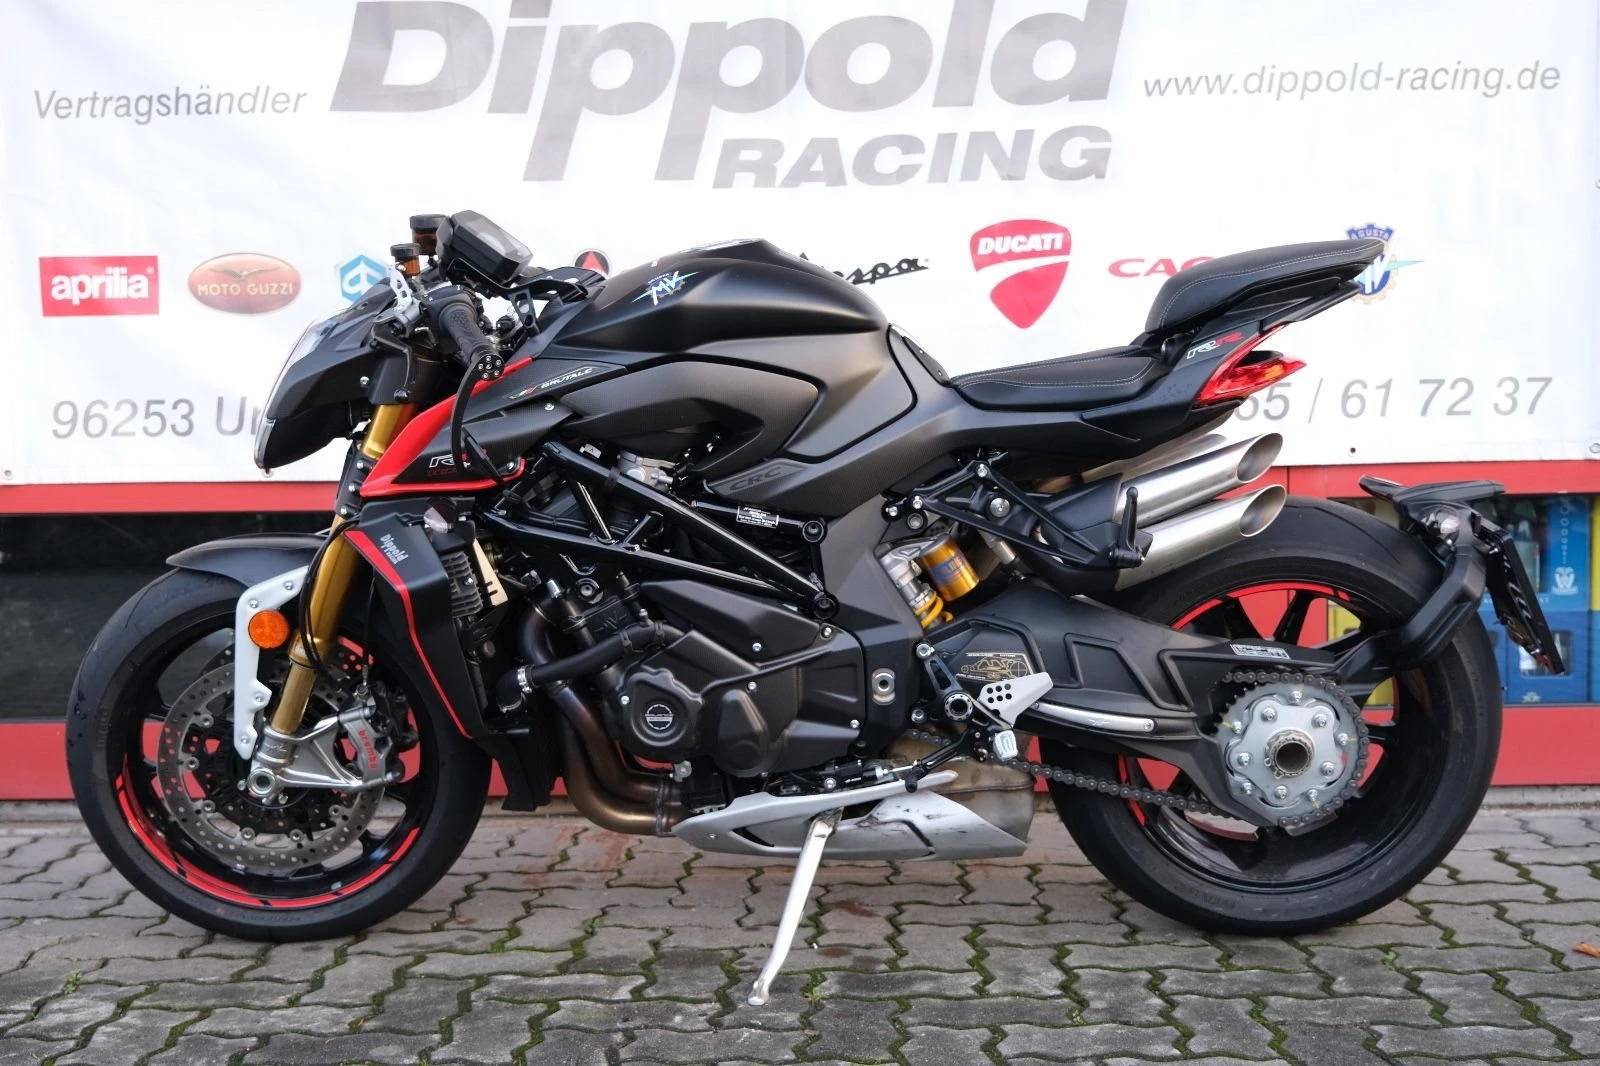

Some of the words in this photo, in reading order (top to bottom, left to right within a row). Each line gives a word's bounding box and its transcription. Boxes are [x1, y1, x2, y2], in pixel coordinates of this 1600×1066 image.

[329, 0, 1127, 182] Dippold
[1143, 60, 1561, 102] www.dippold-racing.de
[34, 84, 308, 126] Vertragshändler
[712, 125, 1113, 190] RACING
[977, 232, 1065, 256] DUCATI
[50, 266, 150, 306] aprilia
[197, 283, 241, 297] MOTO
[247, 281, 294, 296] GUZZI
[541, 367, 595, 390] BRUTALE
[51, 397, 195, 439] 96253
[1307, 377, 1324, 424] /
[1340, 378, 1393, 419] 61
[1418, 377, 1475, 417] 72
[1493, 376, 1553, 416] 37
[380, 533, 409, 562] Dippold
